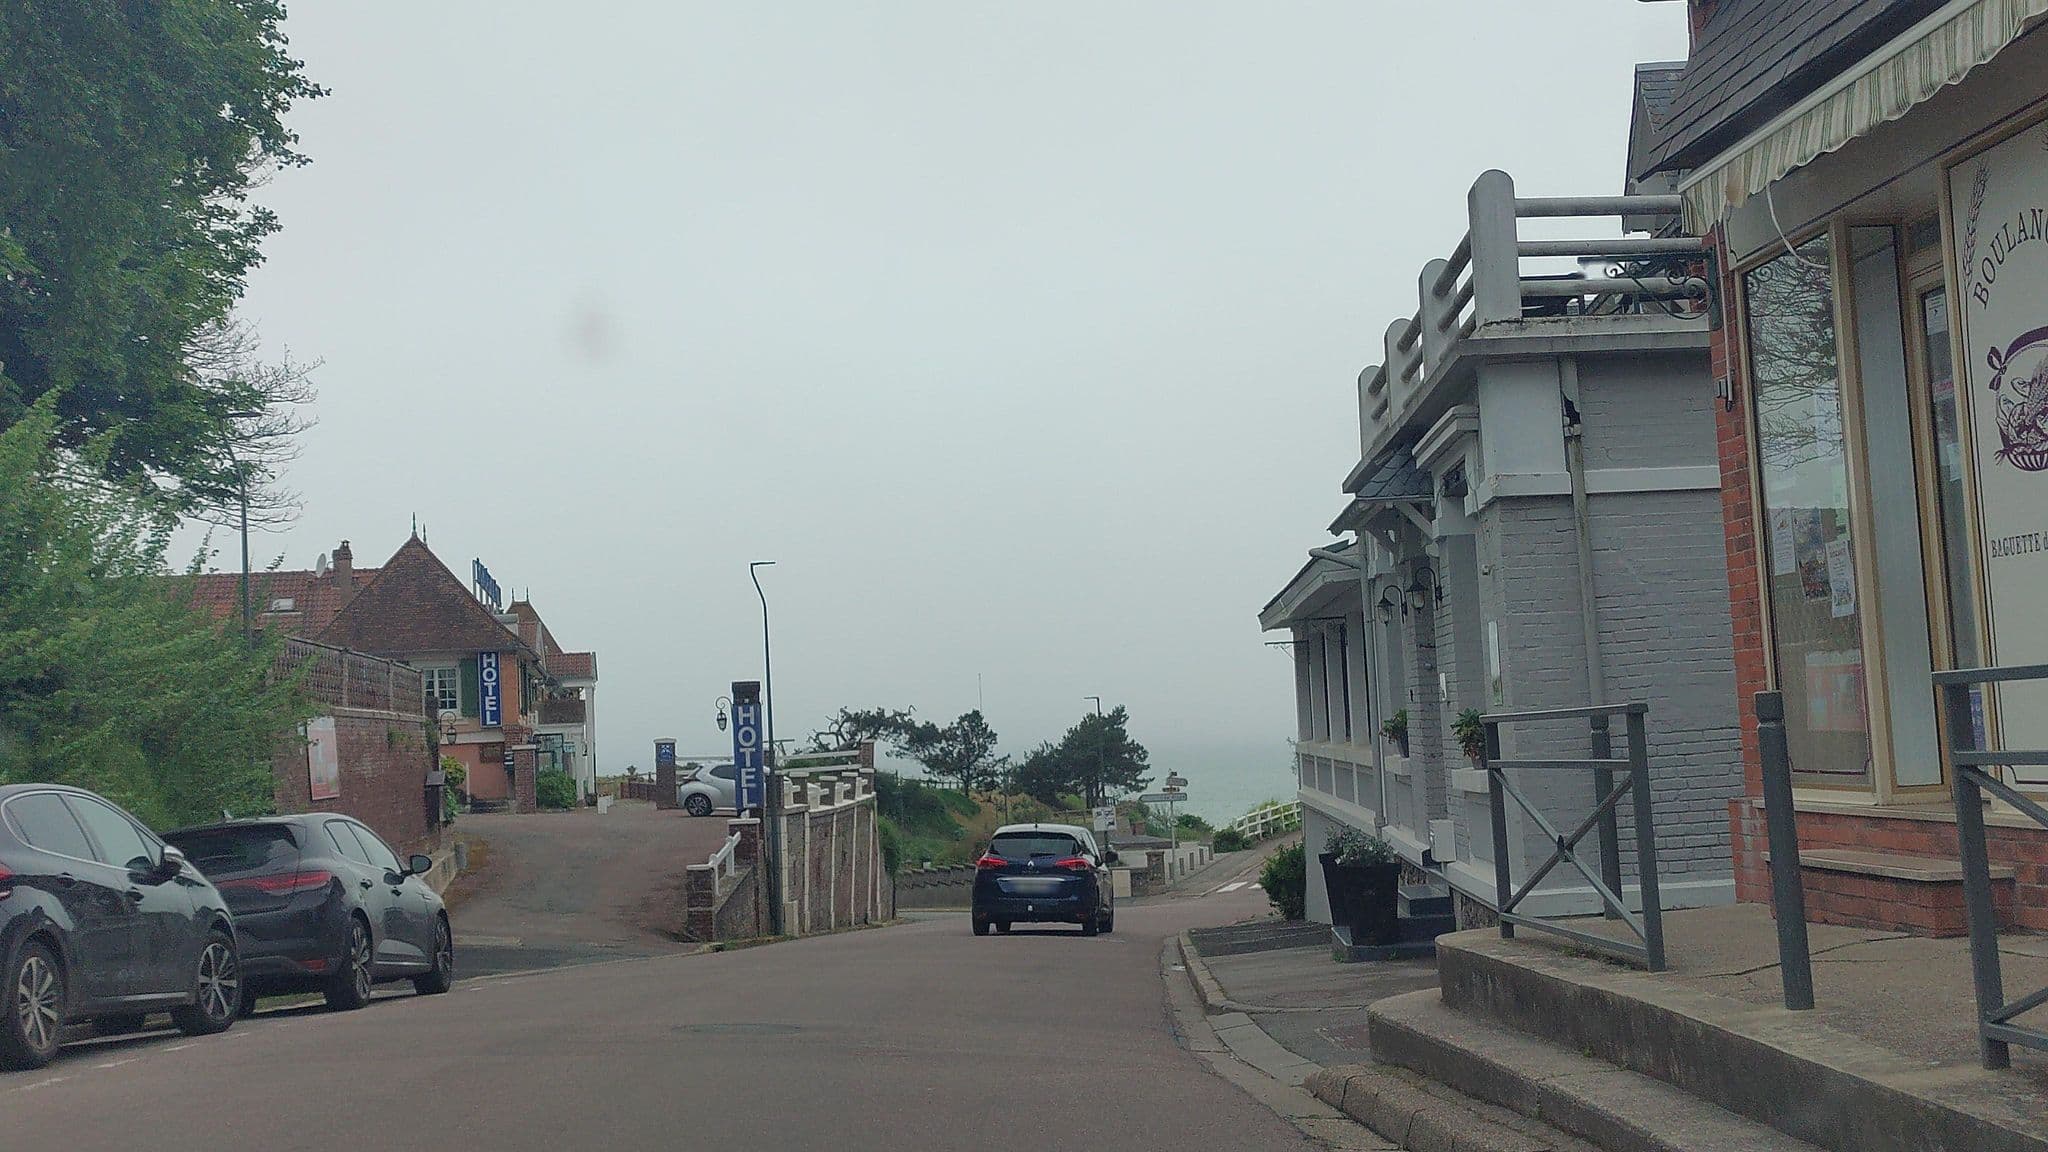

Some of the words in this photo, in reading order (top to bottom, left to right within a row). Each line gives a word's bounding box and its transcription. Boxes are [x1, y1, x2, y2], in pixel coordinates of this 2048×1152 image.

[1973, 208, 2048, 310] BOULAN
[1991, 532, 2041, 558] BAGUETTE
[482, 653, 498, 725] HOTEL
[737, 705, 758, 808] HOTEL
